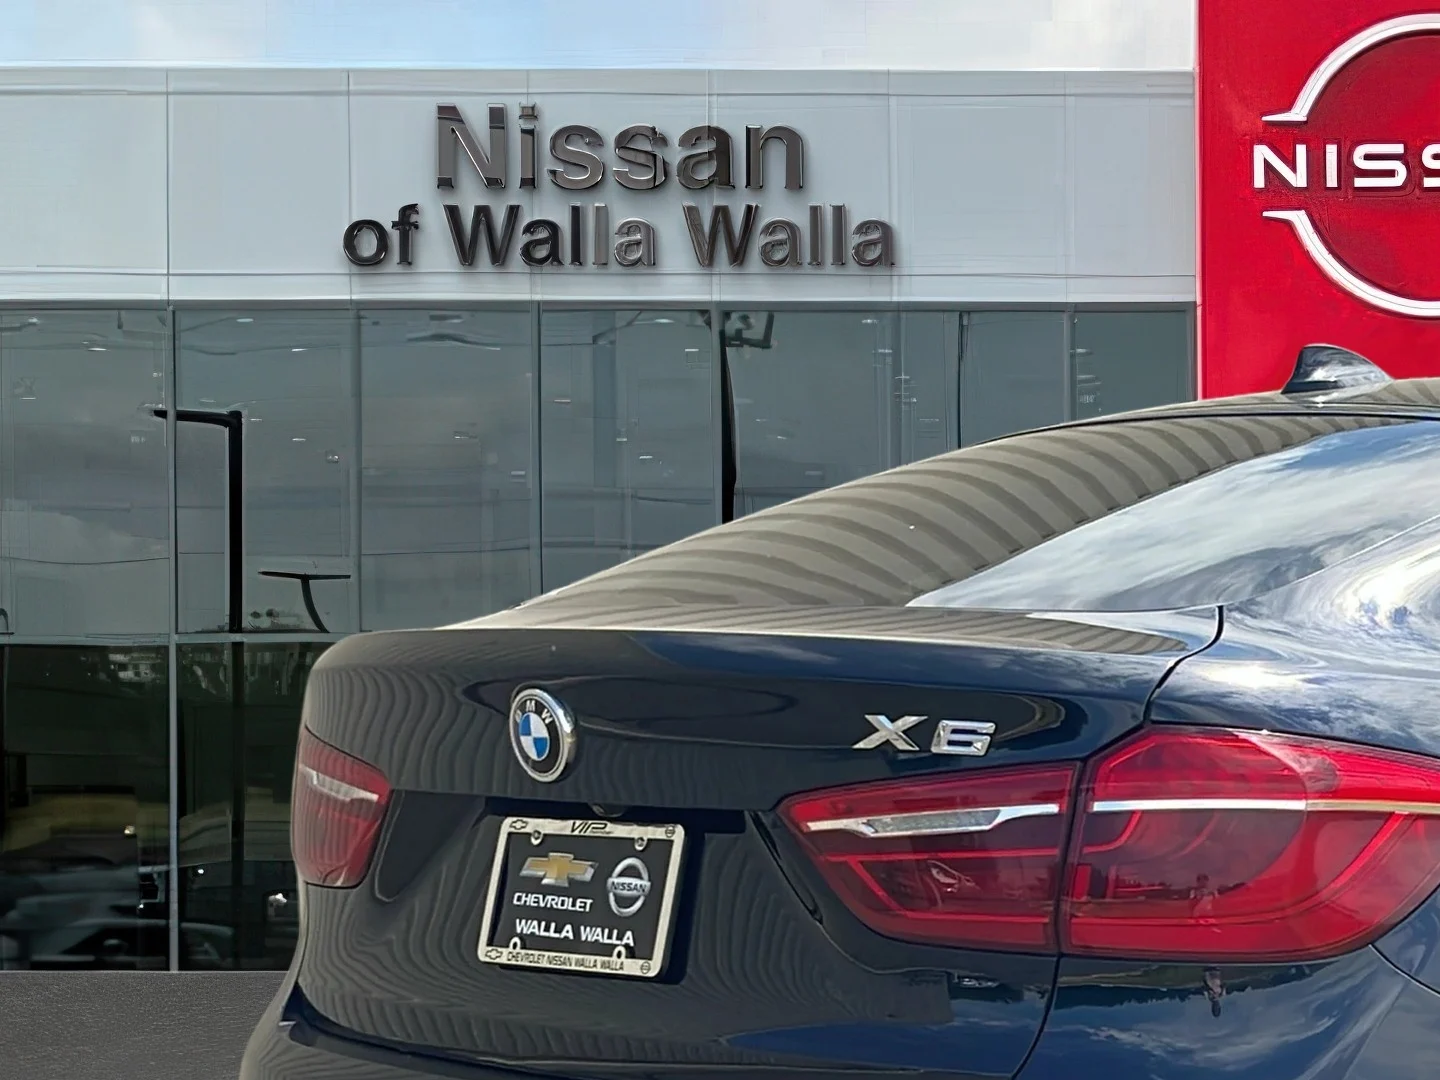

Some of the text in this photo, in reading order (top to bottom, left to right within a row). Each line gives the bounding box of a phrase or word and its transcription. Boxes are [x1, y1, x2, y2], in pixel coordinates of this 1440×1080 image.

[435, 101, 805, 191] Nissan
[342, 202, 896, 267] of Walla Walla
[852, 714, 996, 757] X6
[570, 820, 608, 835] VIP
[611, 879, 648, 894] NISSAN
[513, 892, 593, 913] CHEVROLET
[515, 918, 635, 947] WALLA WALLA
[507, 951, 624, 971] CHEVROLET NISSAN WALLA WALLA
